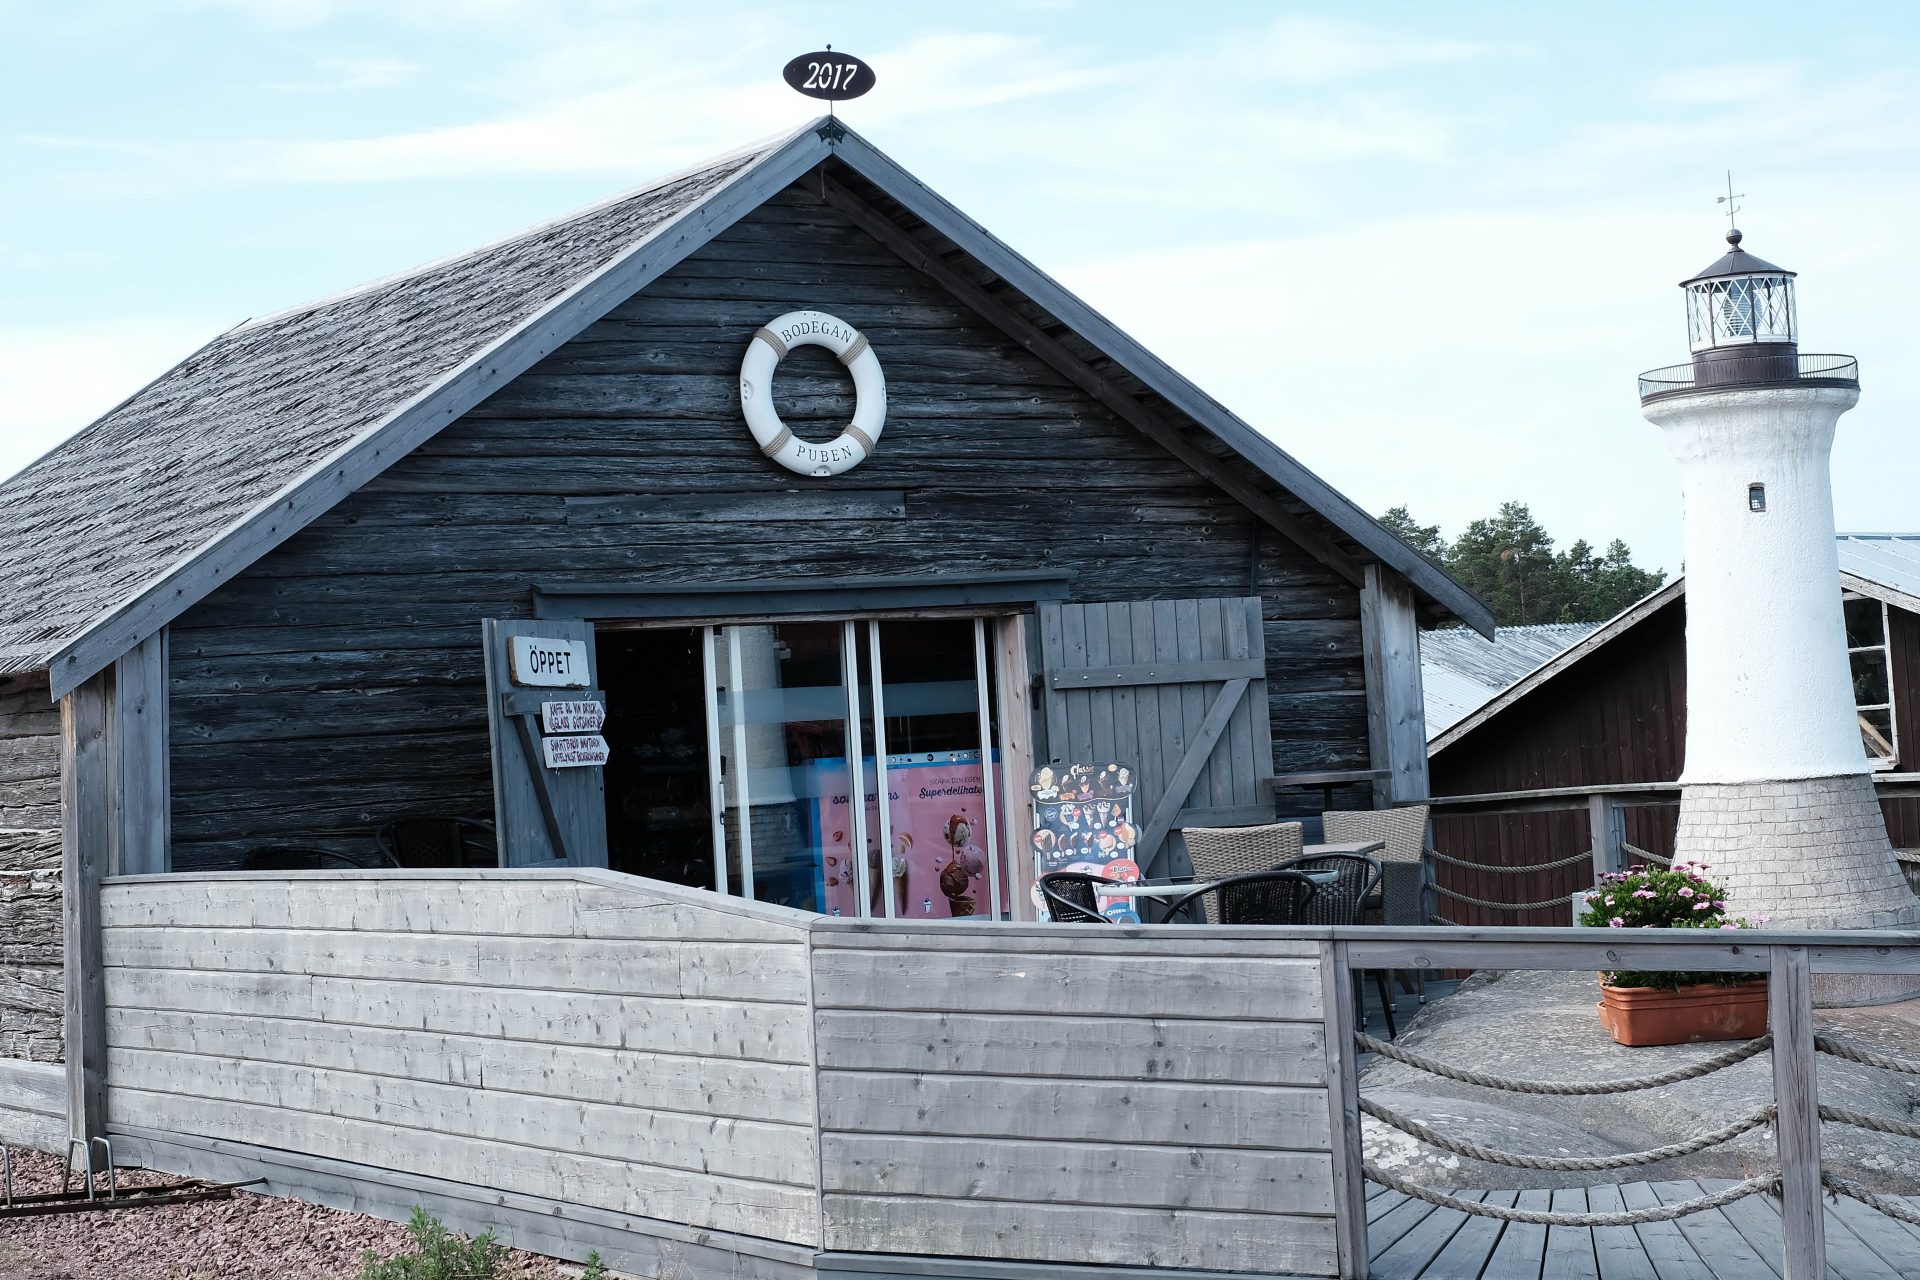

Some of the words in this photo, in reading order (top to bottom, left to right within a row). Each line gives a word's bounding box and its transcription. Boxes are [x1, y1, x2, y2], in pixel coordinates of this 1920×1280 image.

[803, 62, 858, 91] 2017
[781, 321, 853, 344] BODEGAN
[796, 444, 853, 463] PUBEN
[529, 644, 571, 675] ÖPPET
